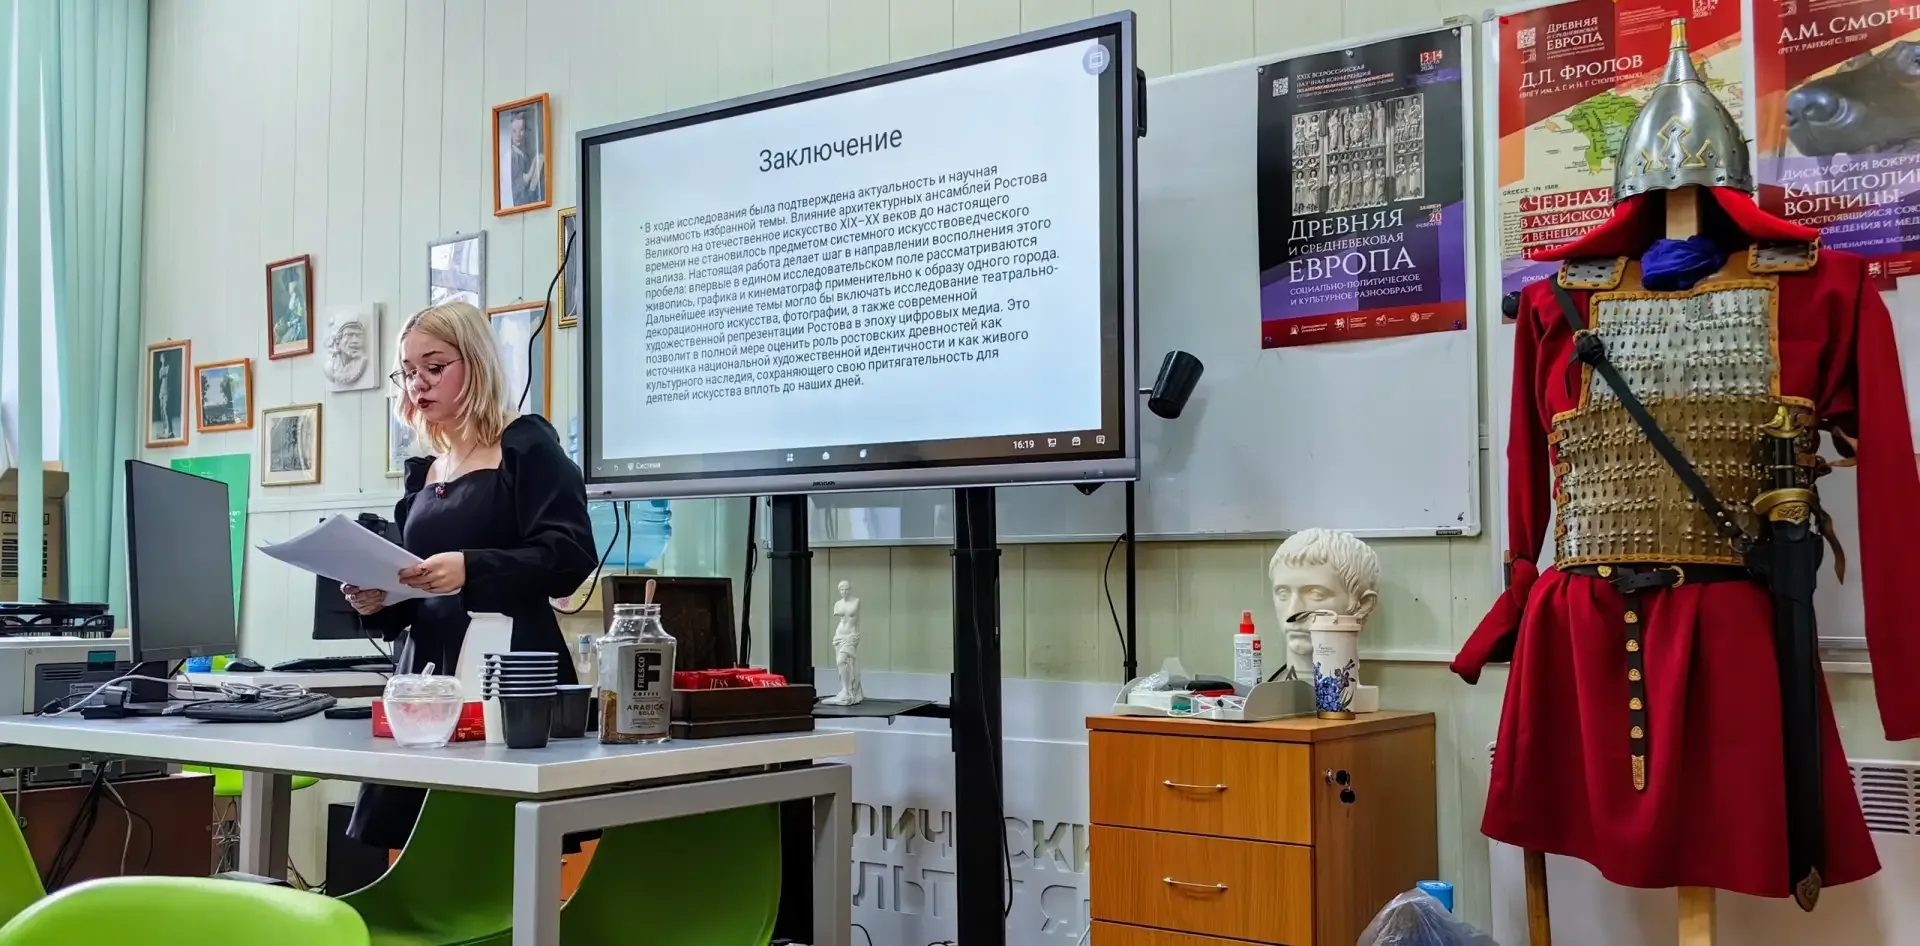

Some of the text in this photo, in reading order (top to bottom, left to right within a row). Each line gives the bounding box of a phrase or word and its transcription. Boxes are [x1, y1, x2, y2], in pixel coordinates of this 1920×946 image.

[1546, 16, 1598, 34] ДРЕВНЯЯ
[1547, 32, 1603, 51] ЕВРОПА
[1778, 21, 1824, 44] А.М.
[1829, 4, 1920, 34] СМОРЧ
[1519, 69, 1555, 91] Д.Л.
[1560, 54, 1643, 80] ФРОЛОВ
[759, 129, 903, 172] Заключение
[1779, 160, 1869, 181] ДИСКУССИЯ
[644, 165, 997, 233] В ходе исследования была подтверждена актуальность и научная
[644, 172, 1047, 246] значимость избранной темы. Влияние архитектурных ансамблей Ростова
[1429, 213, 1442, 222] 20
[1519, 188, 1610, 210] «ЧЕРНАЯ
[1520, 207, 1615, 228] В АХЕЙСКОМ
[1784, 188, 1904, 216] ВОЛЧИЦЫ:
[645, 194, 1009, 259] Великого на отечественное искусство XIX–XX веков до настоящего
[645, 206, 1029, 274] времени не становилось предметом системного искусствоведческого
[1287, 208, 1404, 244] ДРЕВНЯЯ
[1288, 232, 1404, 256] И СРЕДНЕВЕКОВАЯ
[1521, 225, 1602, 242] И ВЕНЕЦИАН
[645, 218, 1051, 285] анализа. Настоящая работа делает шаг в направлении восполнения этого
[645, 236, 1037, 300] пробела: впервые в едином исследовательском поле рассматриваются
[1288, 246, 1416, 284] ЕВРОПА
[645, 249, 1059, 312] живопись, графика и кинематограф применительно к образу одного города.
[645, 265, 1057, 325] Дальнейшее изучение темы могло бы включать исследование театрально-
[1290, 273, 1421, 296] СОЦИАЛЬНО-ПОЛИТИЧЕСКОЕ
[1299, 291, 1352, 305] КУЛЬТУРНОЕ
[1354, 284, 1423, 299] РАЗНООБРАЗИЕ
[645, 287, 977, 339] декорационного искусства, фотографии, а также современной
[645, 298, 1030, 353] художественной репрезентации Ростова в эпоху цифровых медиа. Это
[645, 317, 1002, 364] позволит в полной мере оценить роль ростовских древностей как
[646, 330, 1028, 377] источника национальной художественной идентичности и как живого
[646, 348, 998, 392] культурного наследия, сохраняющего свою притягательность для
[645, 373, 863, 405] деятелей искусства вплоть до наших дней.
[1013, 440, 1035, 449] 16:19
[637, 656, 646, 688] FRESCO
